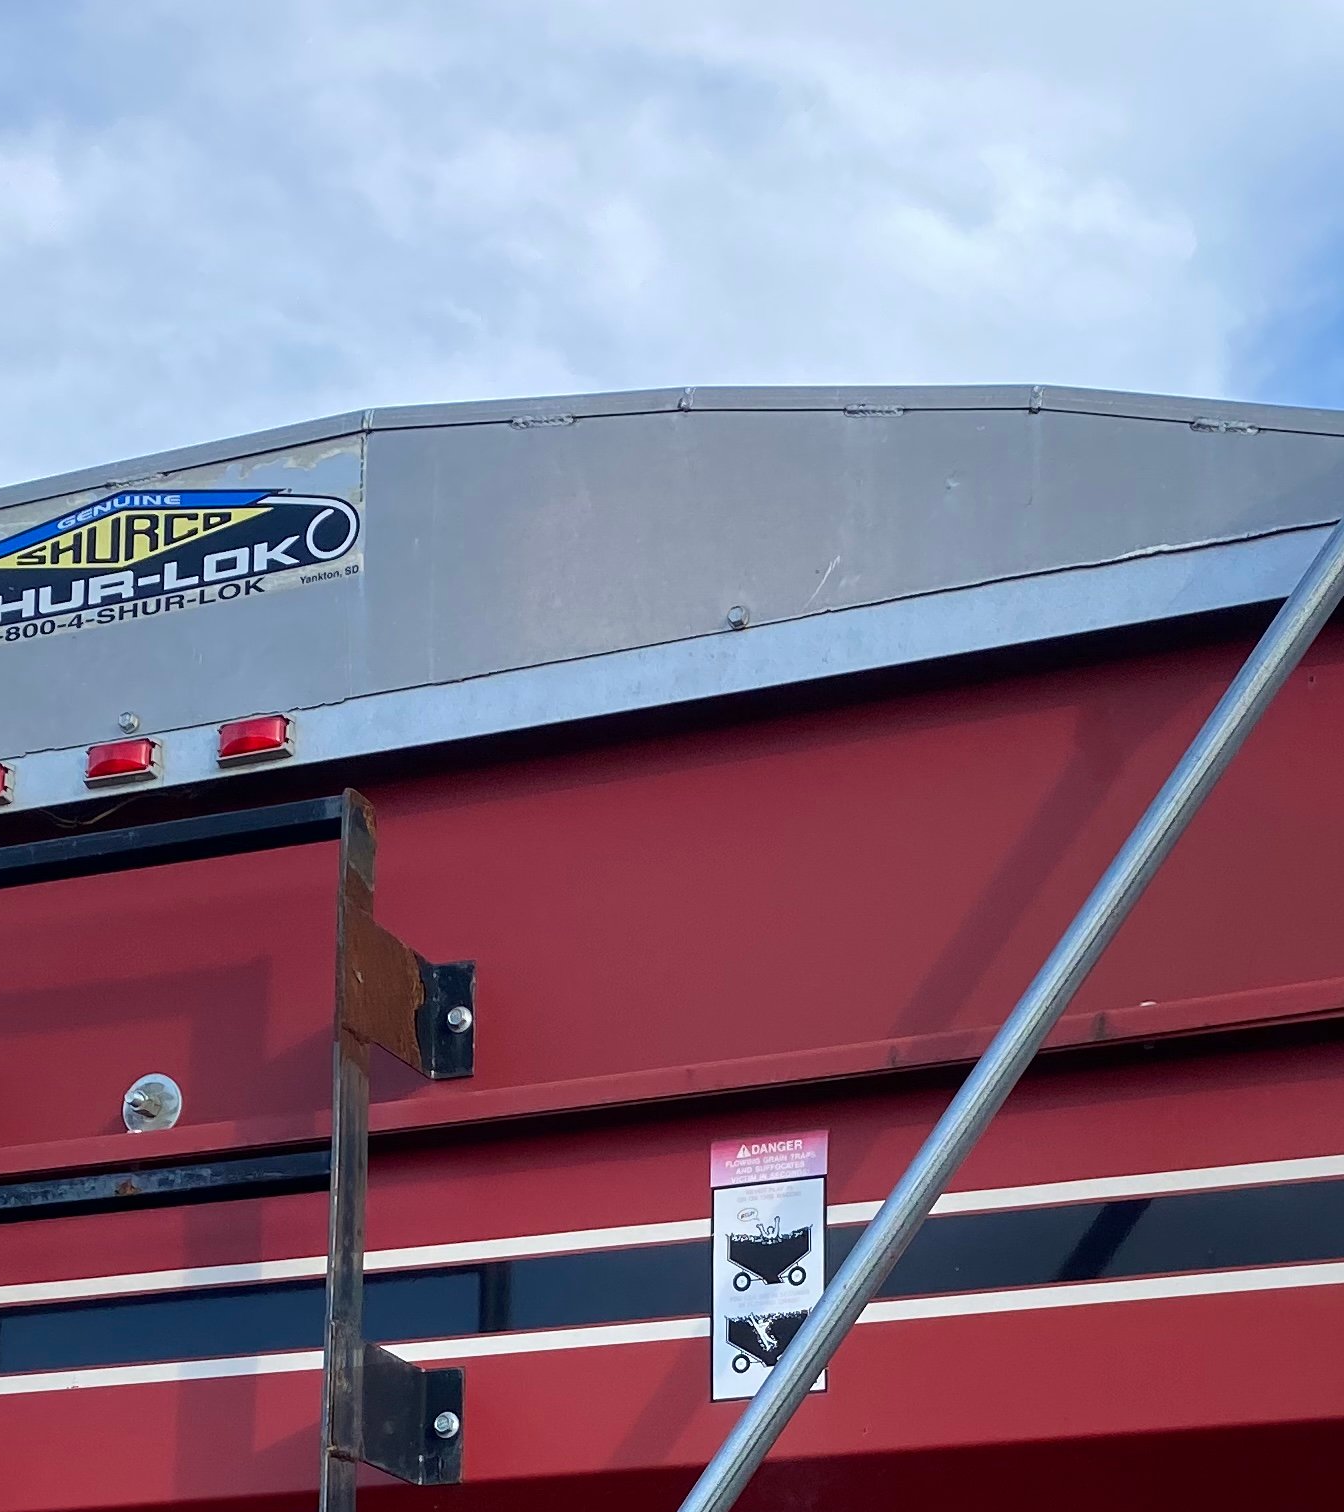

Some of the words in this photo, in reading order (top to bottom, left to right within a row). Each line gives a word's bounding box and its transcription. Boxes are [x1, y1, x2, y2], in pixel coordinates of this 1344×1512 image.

[57, 494, 181, 530] GENUINE
[17, 512, 233, 565] SHURCO
[299, 569, 343, 585] Yankton,
[344, 564, 360, 575] SD
[751, 1139, 803, 1155] DANGER
[725, 1158, 760, 1168] FLOWING
[763, 1155, 787, 1164] GRAIN
[790, 1151, 816, 1160] TRAPS
[736, 1166, 752, 1175] AND
[755, 1161, 805, 1173] SUFFOCATES
[731, 1175, 756, 1184] VICTIM
[759, 1173, 767, 1181] IN
